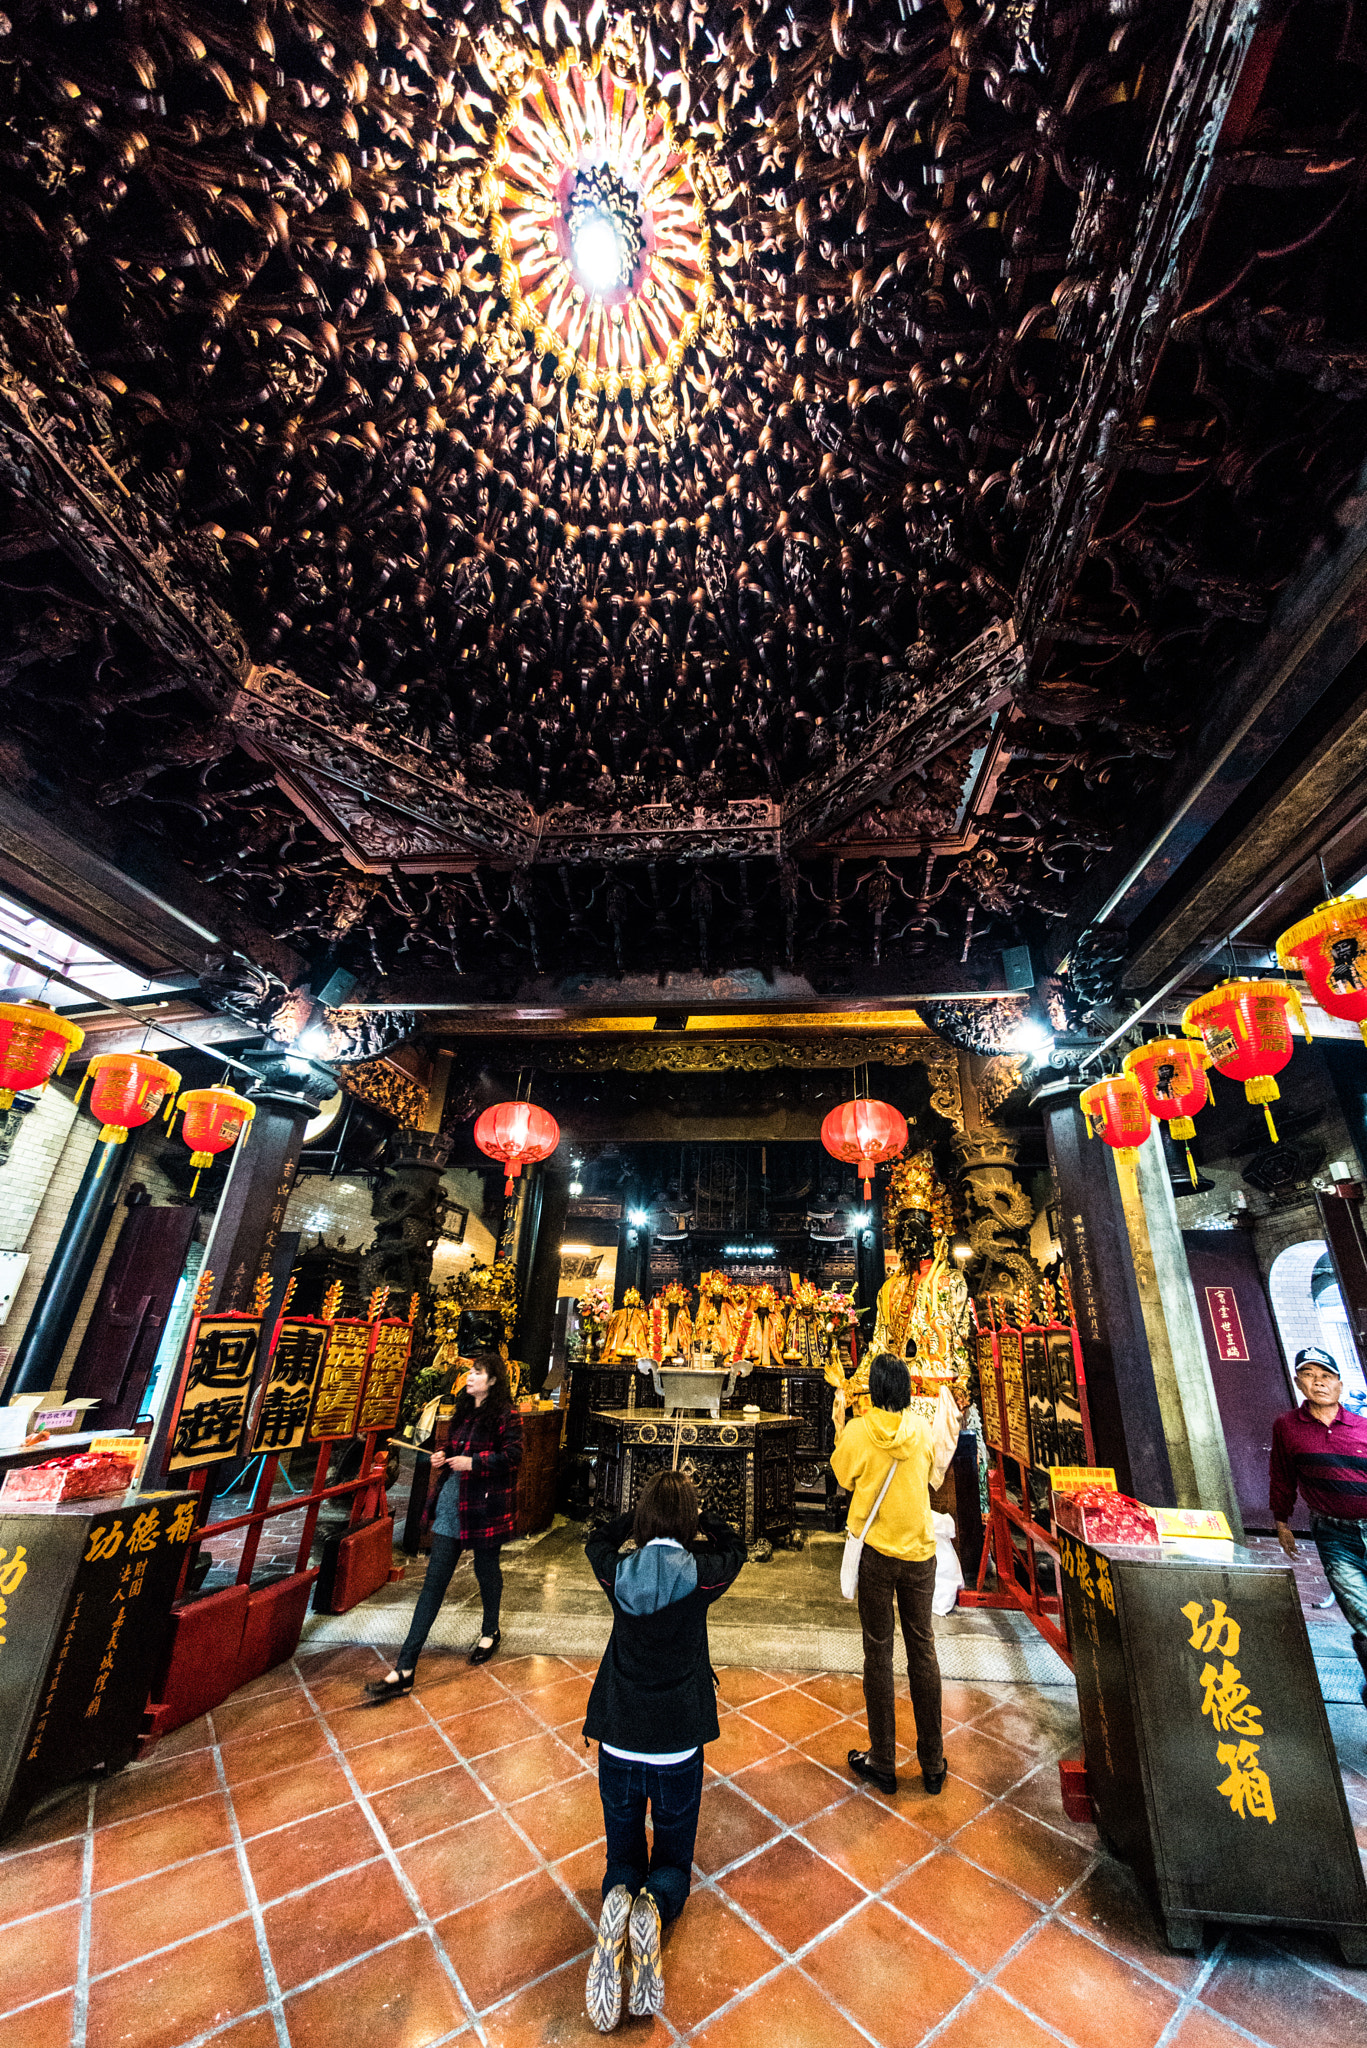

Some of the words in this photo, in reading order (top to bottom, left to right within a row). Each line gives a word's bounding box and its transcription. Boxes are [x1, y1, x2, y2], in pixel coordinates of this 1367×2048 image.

[1255, 997, 1288, 1053] 風調雨順
[173, 1328, 258, 1457] 迴避
[254, 1329, 324, 1449] 肅靜
[84, 1500, 198, 1562] 功德箱
[1059, 1536, 1117, 1617] 功德箱
[1180, 1599, 1277, 1825] 功德箱
